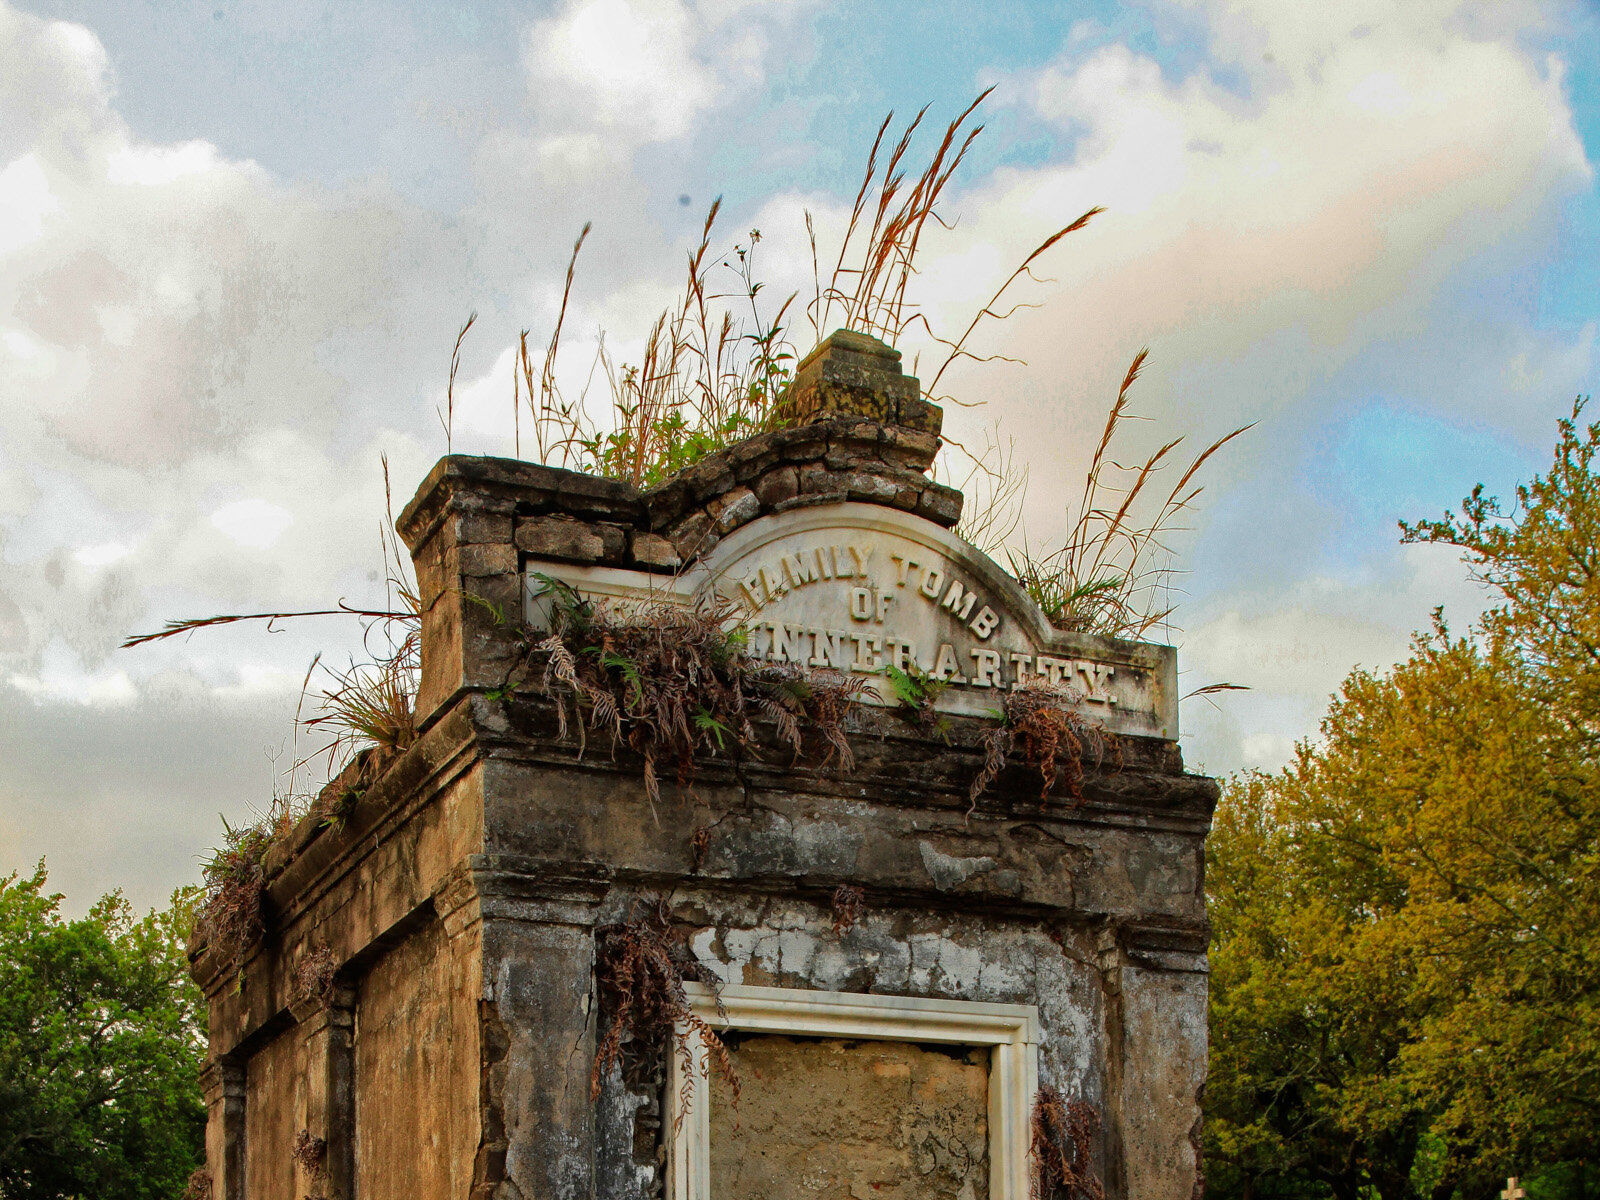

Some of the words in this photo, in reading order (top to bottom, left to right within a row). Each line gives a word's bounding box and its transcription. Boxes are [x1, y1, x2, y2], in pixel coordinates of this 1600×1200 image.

[739, 545, 874, 610] FAMILY
[891, 552, 999, 640] TOMB
[851, 586, 895, 624] OF
